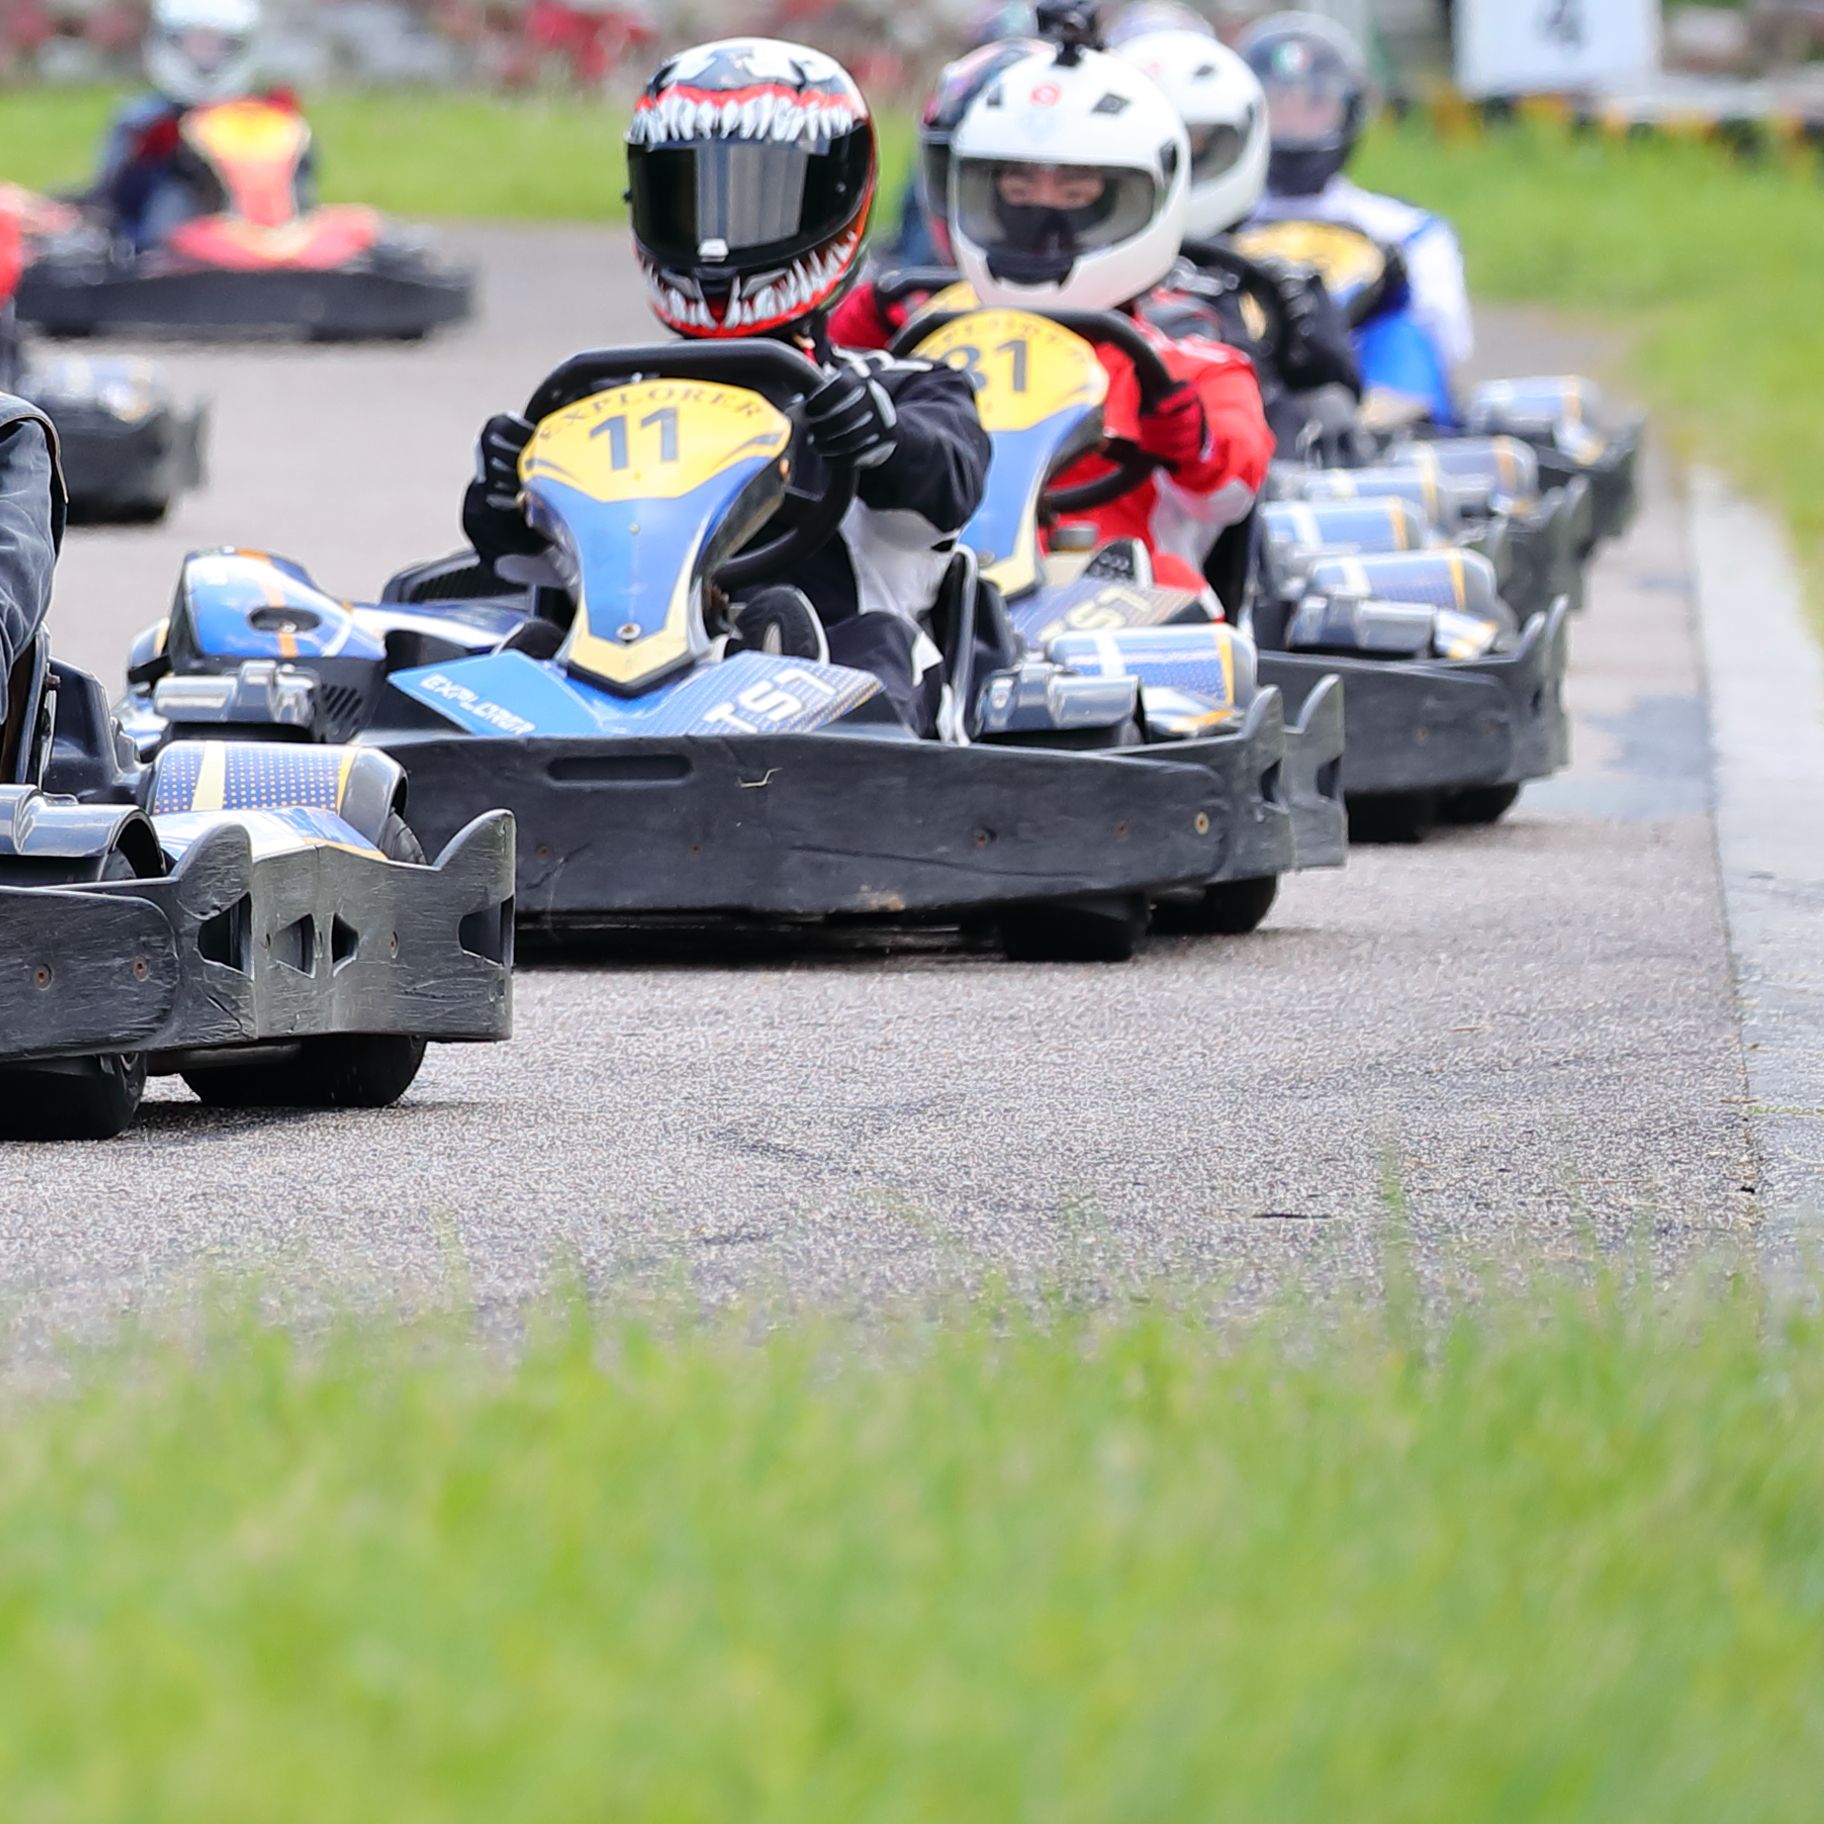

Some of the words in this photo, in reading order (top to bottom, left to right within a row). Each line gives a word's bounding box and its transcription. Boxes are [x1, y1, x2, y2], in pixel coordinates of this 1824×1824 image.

[539, 386, 763, 440] EXPLORER
[588, 406, 680, 472] 11
[1038, 586, 1152, 642] S7
[419, 672, 537, 736] EXPLORER
[702, 668, 837, 734] TS7
